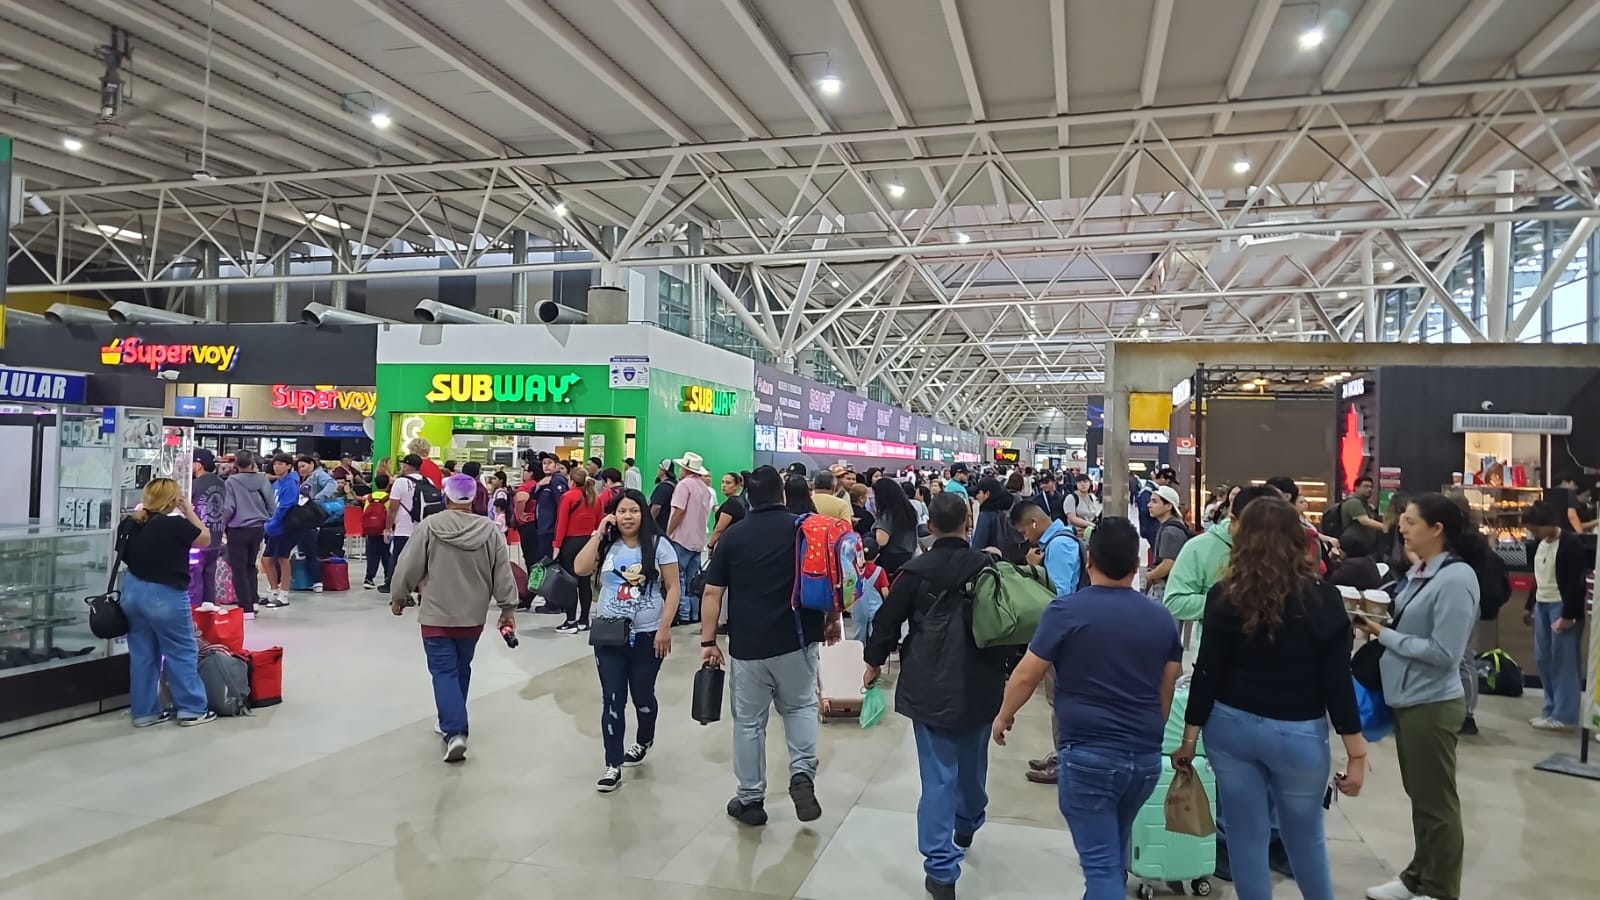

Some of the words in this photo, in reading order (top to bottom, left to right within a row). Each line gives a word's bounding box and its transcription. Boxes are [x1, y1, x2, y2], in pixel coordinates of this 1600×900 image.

[122, 336, 236, 371] Supervoy
[271, 384, 376, 417] Supervoy
[426, 373, 582, 403] SUBWAY
[685, 385, 737, 416] SUBWAY
